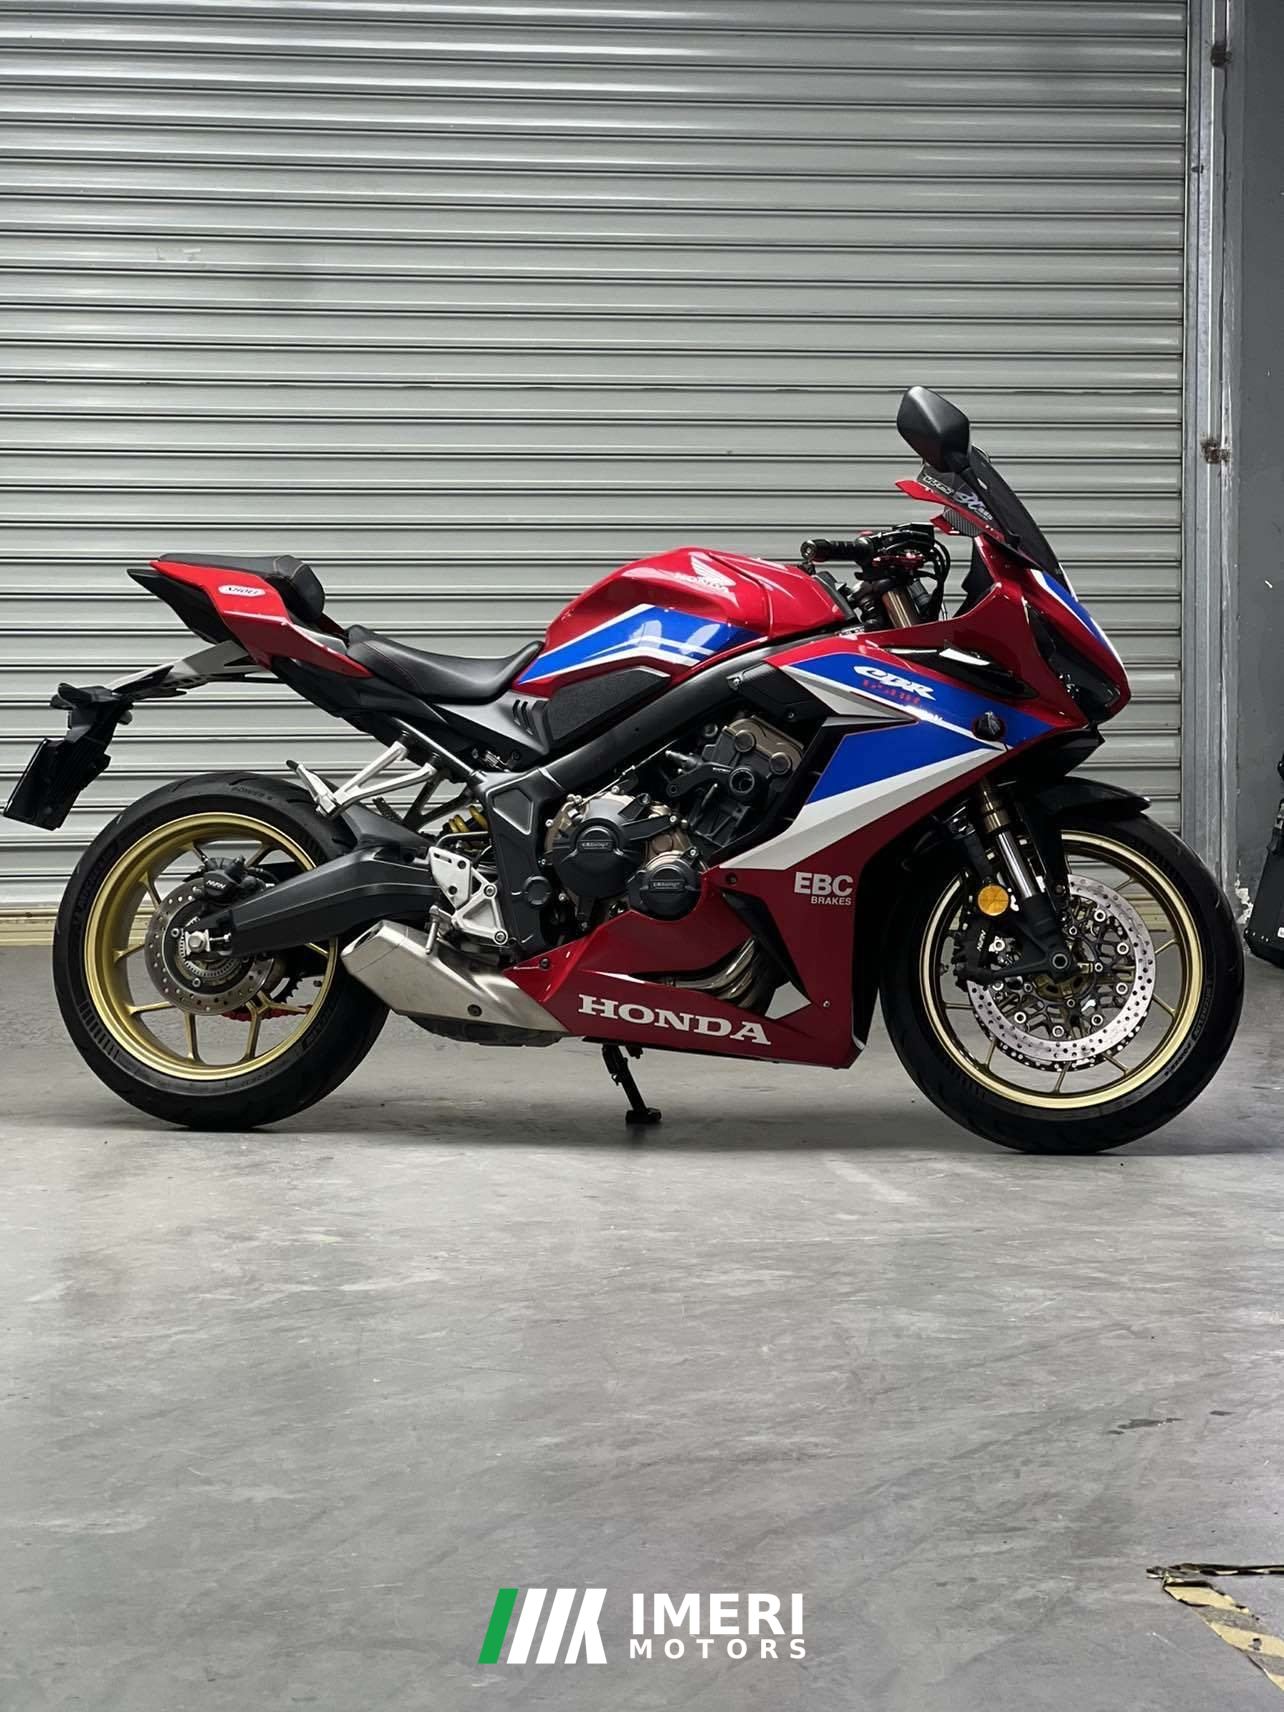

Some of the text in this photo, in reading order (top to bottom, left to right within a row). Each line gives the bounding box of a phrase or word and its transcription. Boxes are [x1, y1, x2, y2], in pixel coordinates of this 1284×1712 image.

[853, 665, 937, 702] CBR
[794, 871, 854, 897] EBC
[810, 896, 852, 906] BRAKES
[578, 994, 772, 1046] HONDA
